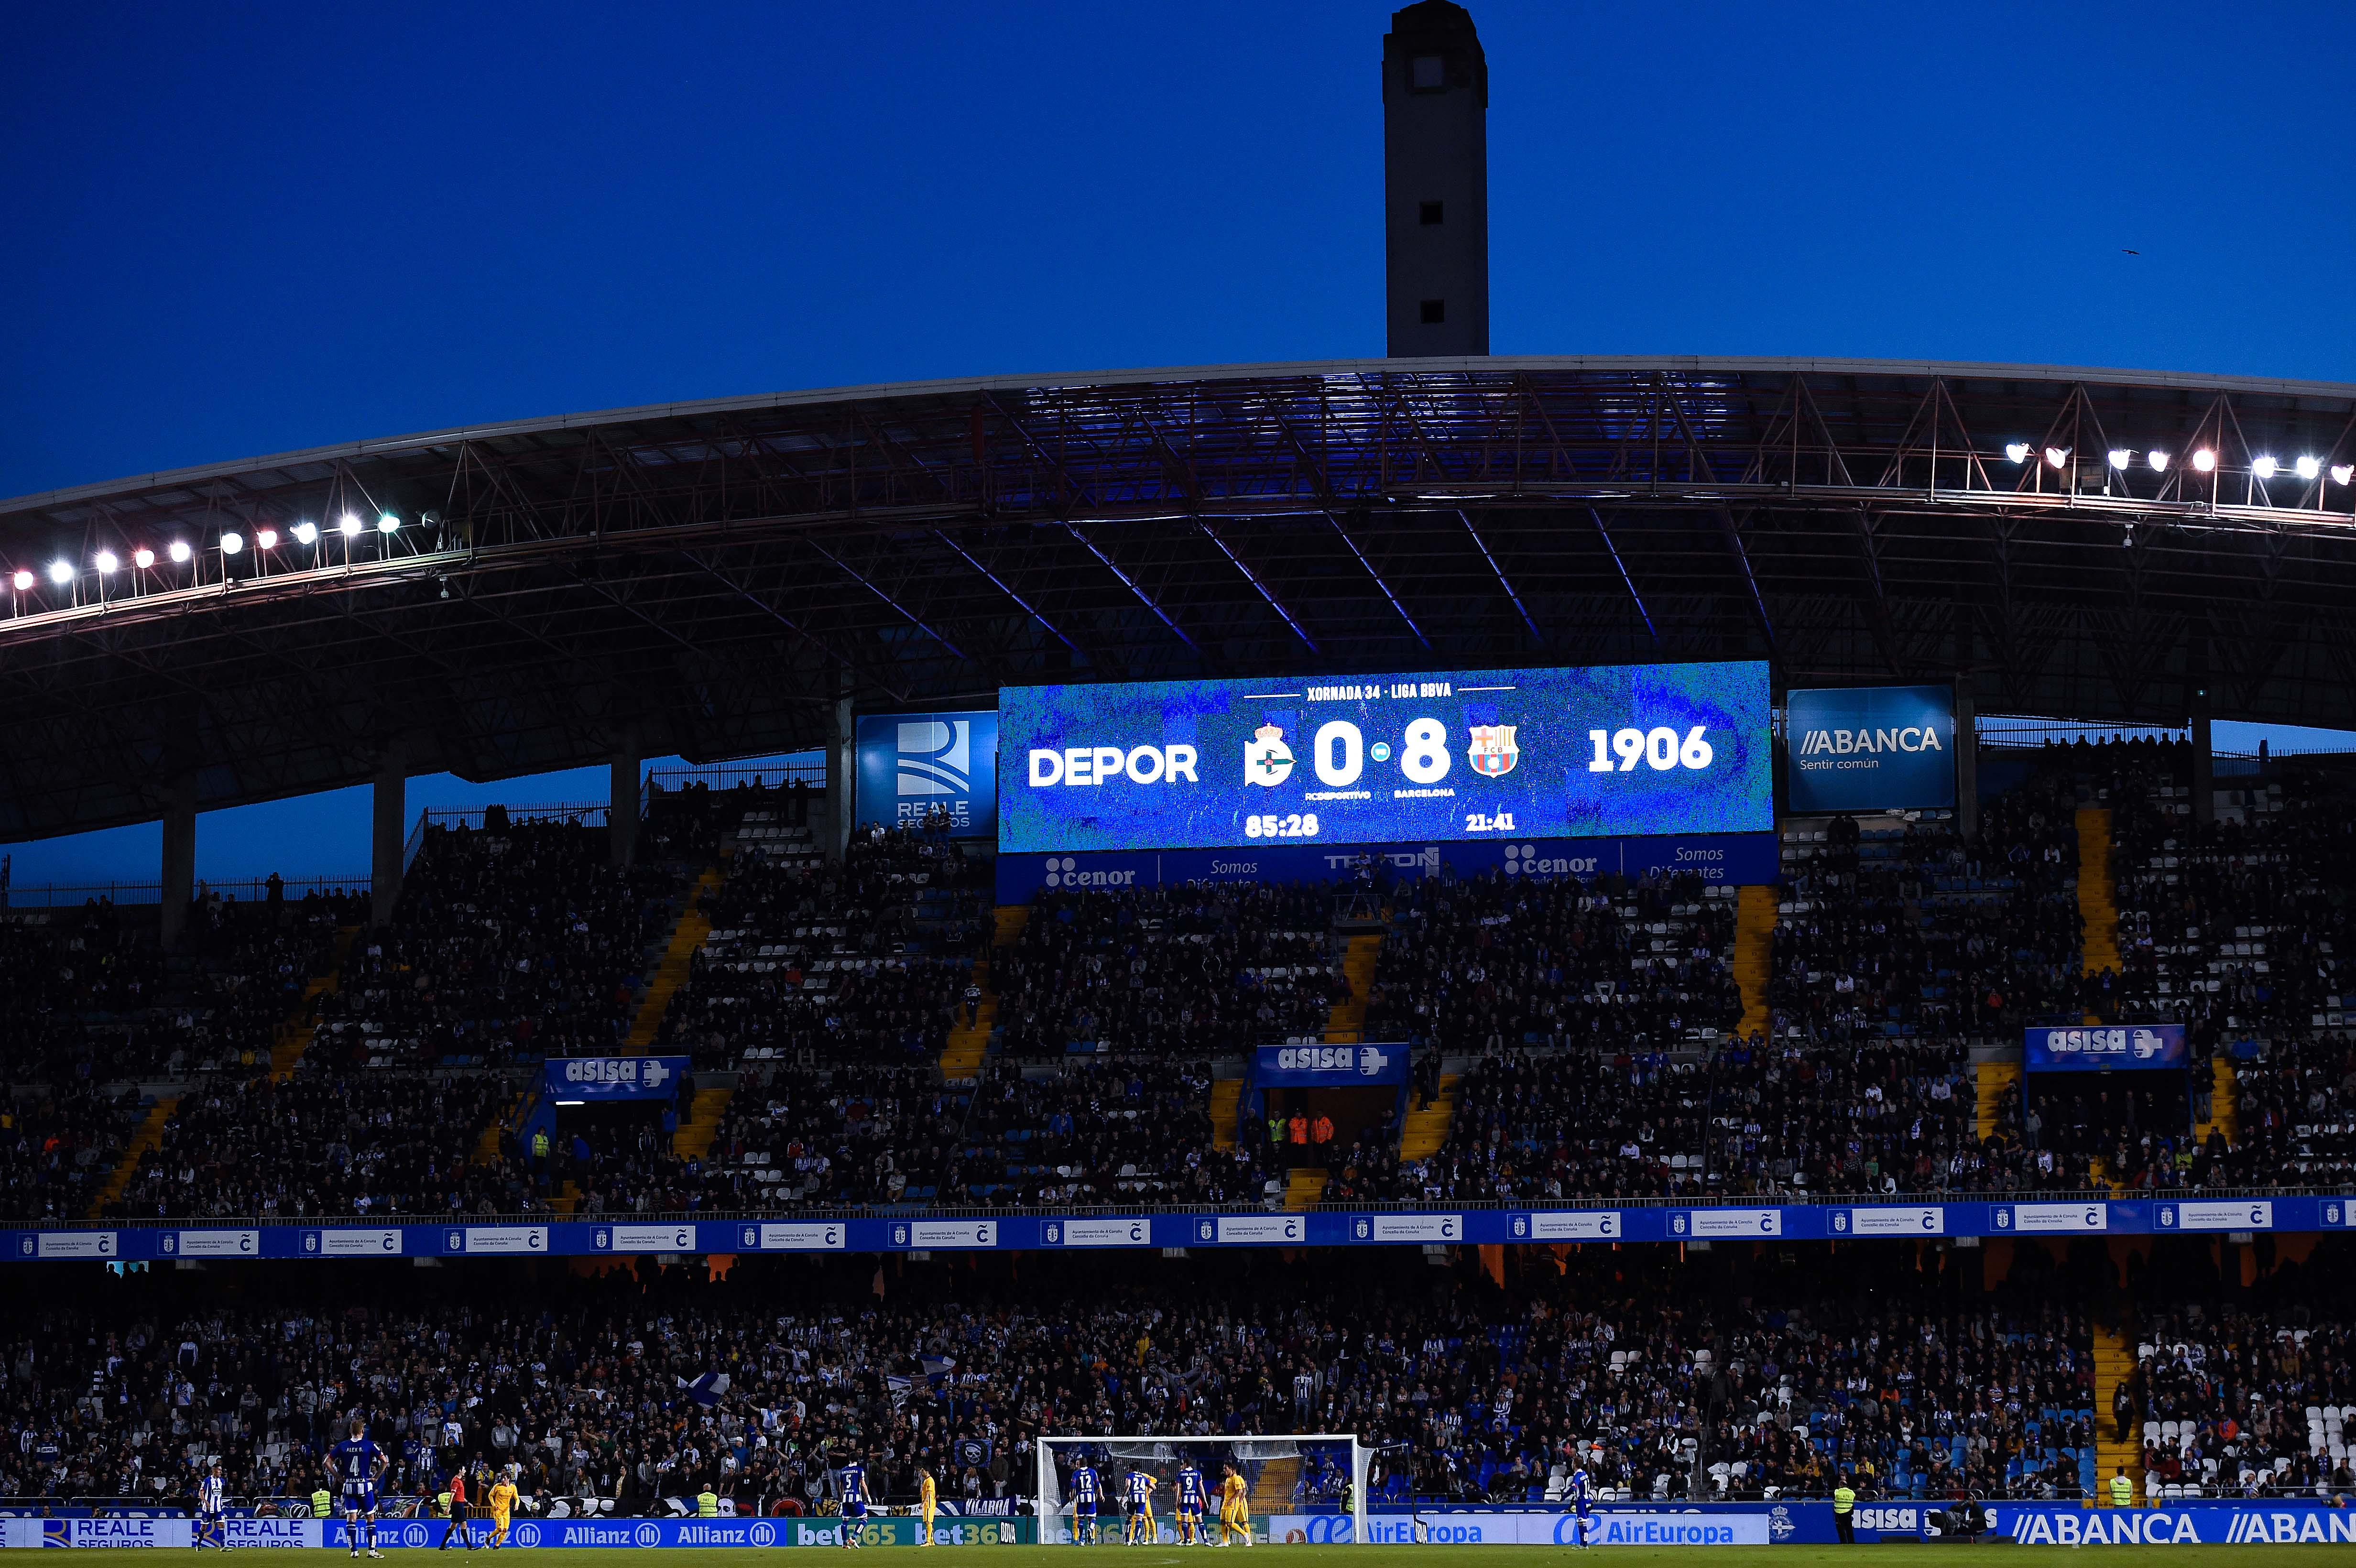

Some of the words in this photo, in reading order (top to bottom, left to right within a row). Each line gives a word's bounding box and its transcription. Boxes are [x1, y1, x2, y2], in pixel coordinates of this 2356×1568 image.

[1307, 686, 1363, 701] XORNADA
[1365, 685, 1381, 699] 34
[1391, 684, 1418, 698] LIGA
[1420, 683, 1451, 697] BBVA
[1314, 720, 1363, 787] 0
[1400, 717, 1451, 784] 8
[1589, 726, 1713, 773] 1906
[1028, 744, 1199, 787] DEPOR
[1800, 759, 1834, 770] Sentir
[1837, 758, 1878, 769] común
[1394, 788, 1455, 798] BARCELONA
[1245, 814, 1319, 838] 85:28
[1465, 813, 1515, 832] 21:41
[1675, 847, 1723, 861] Somos
[1211, 860, 1258, 874] Somos
[1522, 857, 1597, 873] cenor
[1063, 870, 1135, 886] cenor
[2047, 1030, 2126, 1052] asisa
[1278, 1048, 1353, 1069] asisa
[566, 1061, 636, 1081] asisa
[349, 1456, 360, 1476] 4
[846, 1474, 851, 1489] 5
[1079, 1475, 1091, 1488] 12
[1133, 1477, 1146, 1490] 24
[1186, 1476, 1193, 1490] 9
[77, 1520, 154, 1536] REALE
[227, 1520, 304, 1536] REALE
[563, 1527, 630, 1544] Allianz
[677, 1526, 745, 1544] Allianz
[1607, 1521, 1733, 1544] AirEuropa
